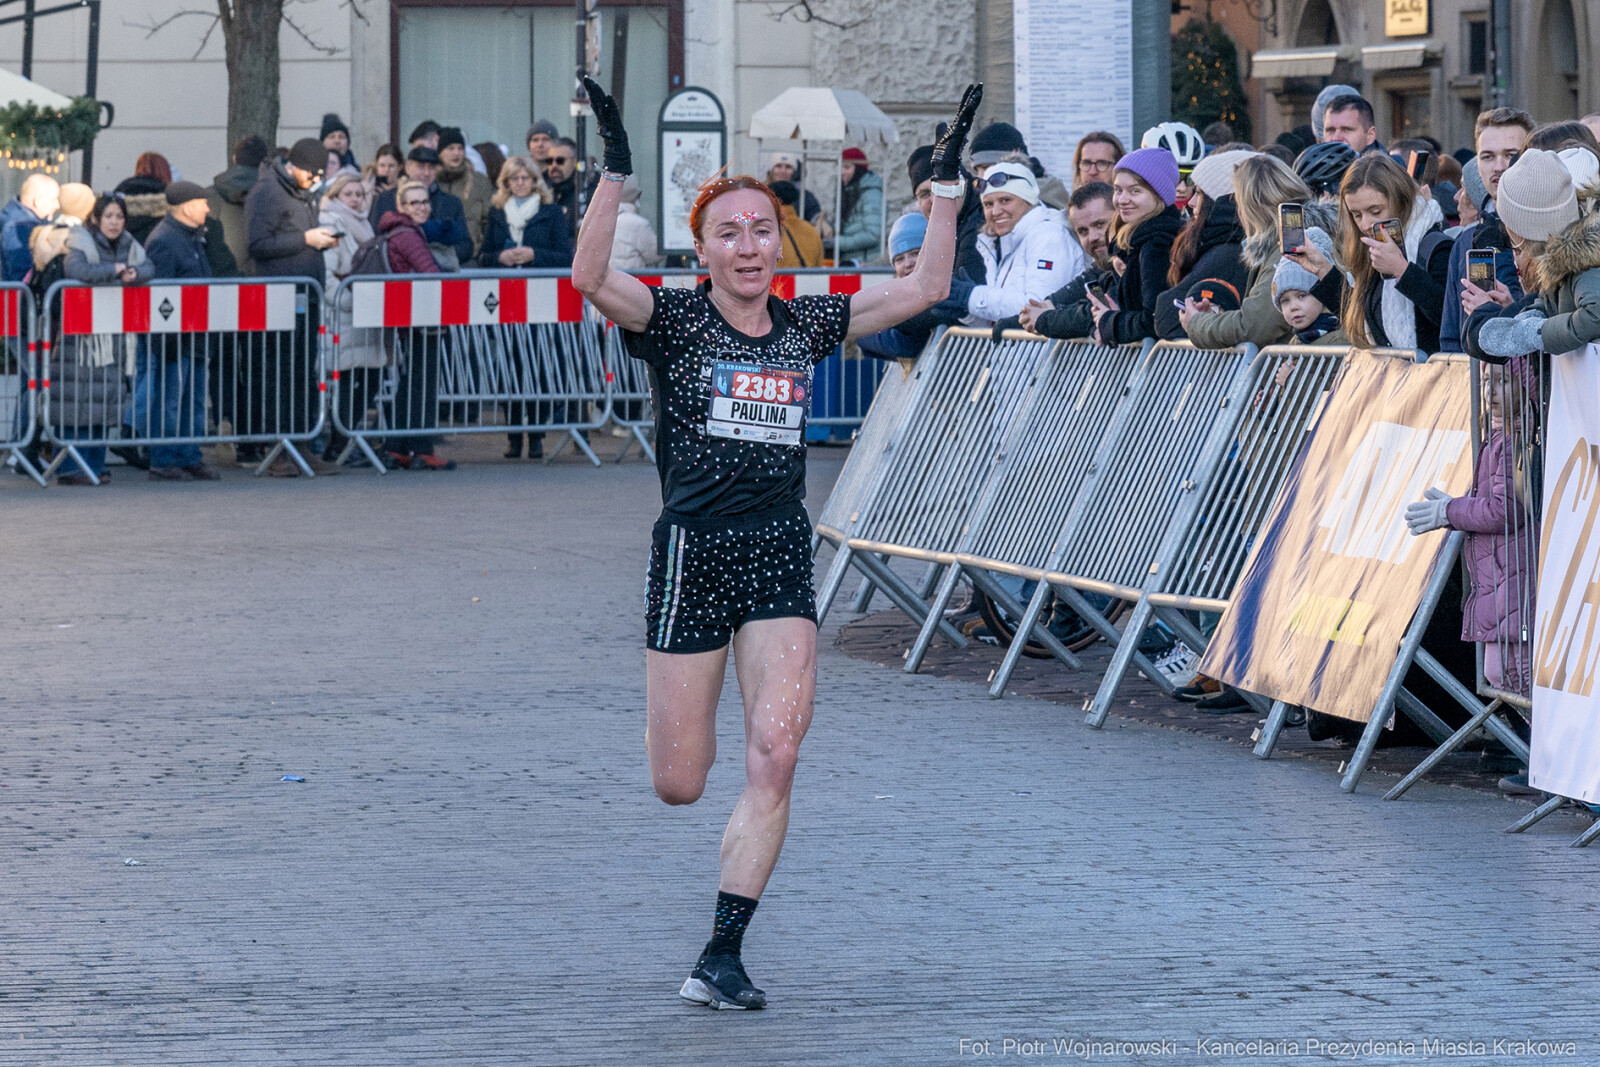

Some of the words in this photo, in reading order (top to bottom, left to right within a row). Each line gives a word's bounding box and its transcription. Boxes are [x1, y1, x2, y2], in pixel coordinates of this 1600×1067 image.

[726, 364, 762, 374] KRAKOWSKI
[735, 374, 791, 402] 2383
[730, 401, 787, 425] PAULINA
